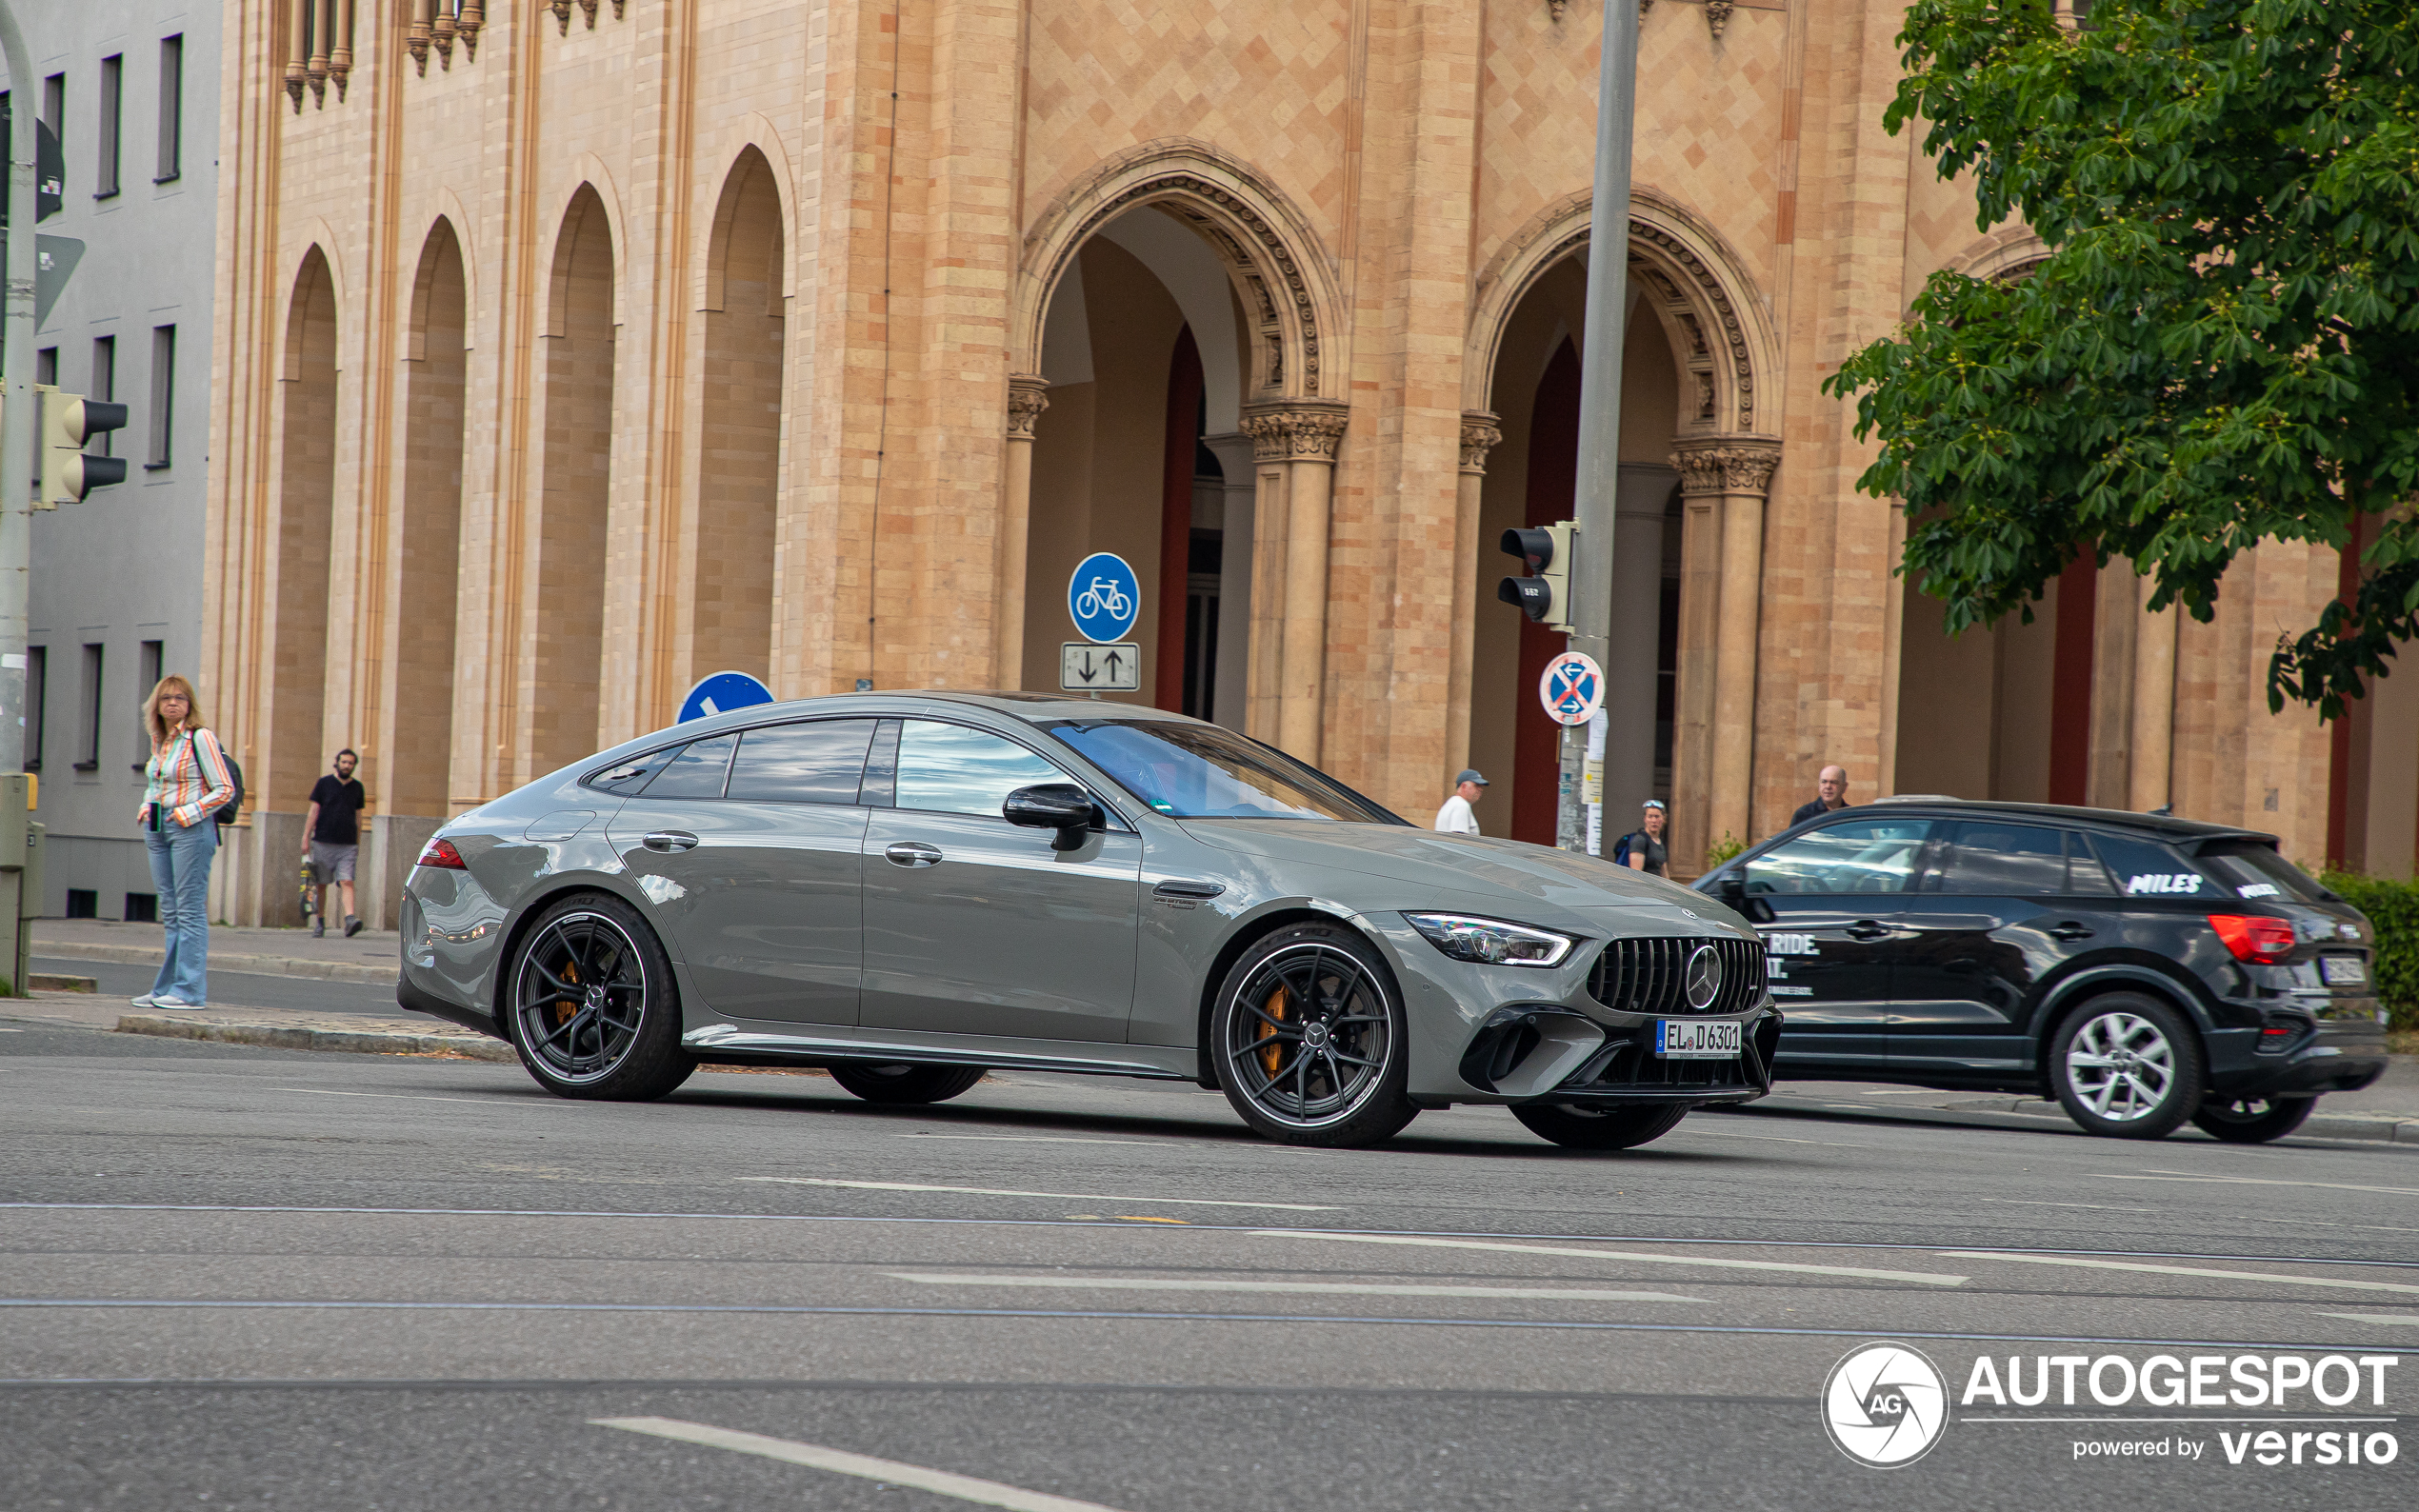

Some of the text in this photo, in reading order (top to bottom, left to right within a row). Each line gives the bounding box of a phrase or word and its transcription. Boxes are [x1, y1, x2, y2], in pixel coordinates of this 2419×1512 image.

[2128, 874, 2204, 894] MILES
[1769, 933, 1821, 955] RIDE.
[1667, 1025, 1687, 1050] EL
